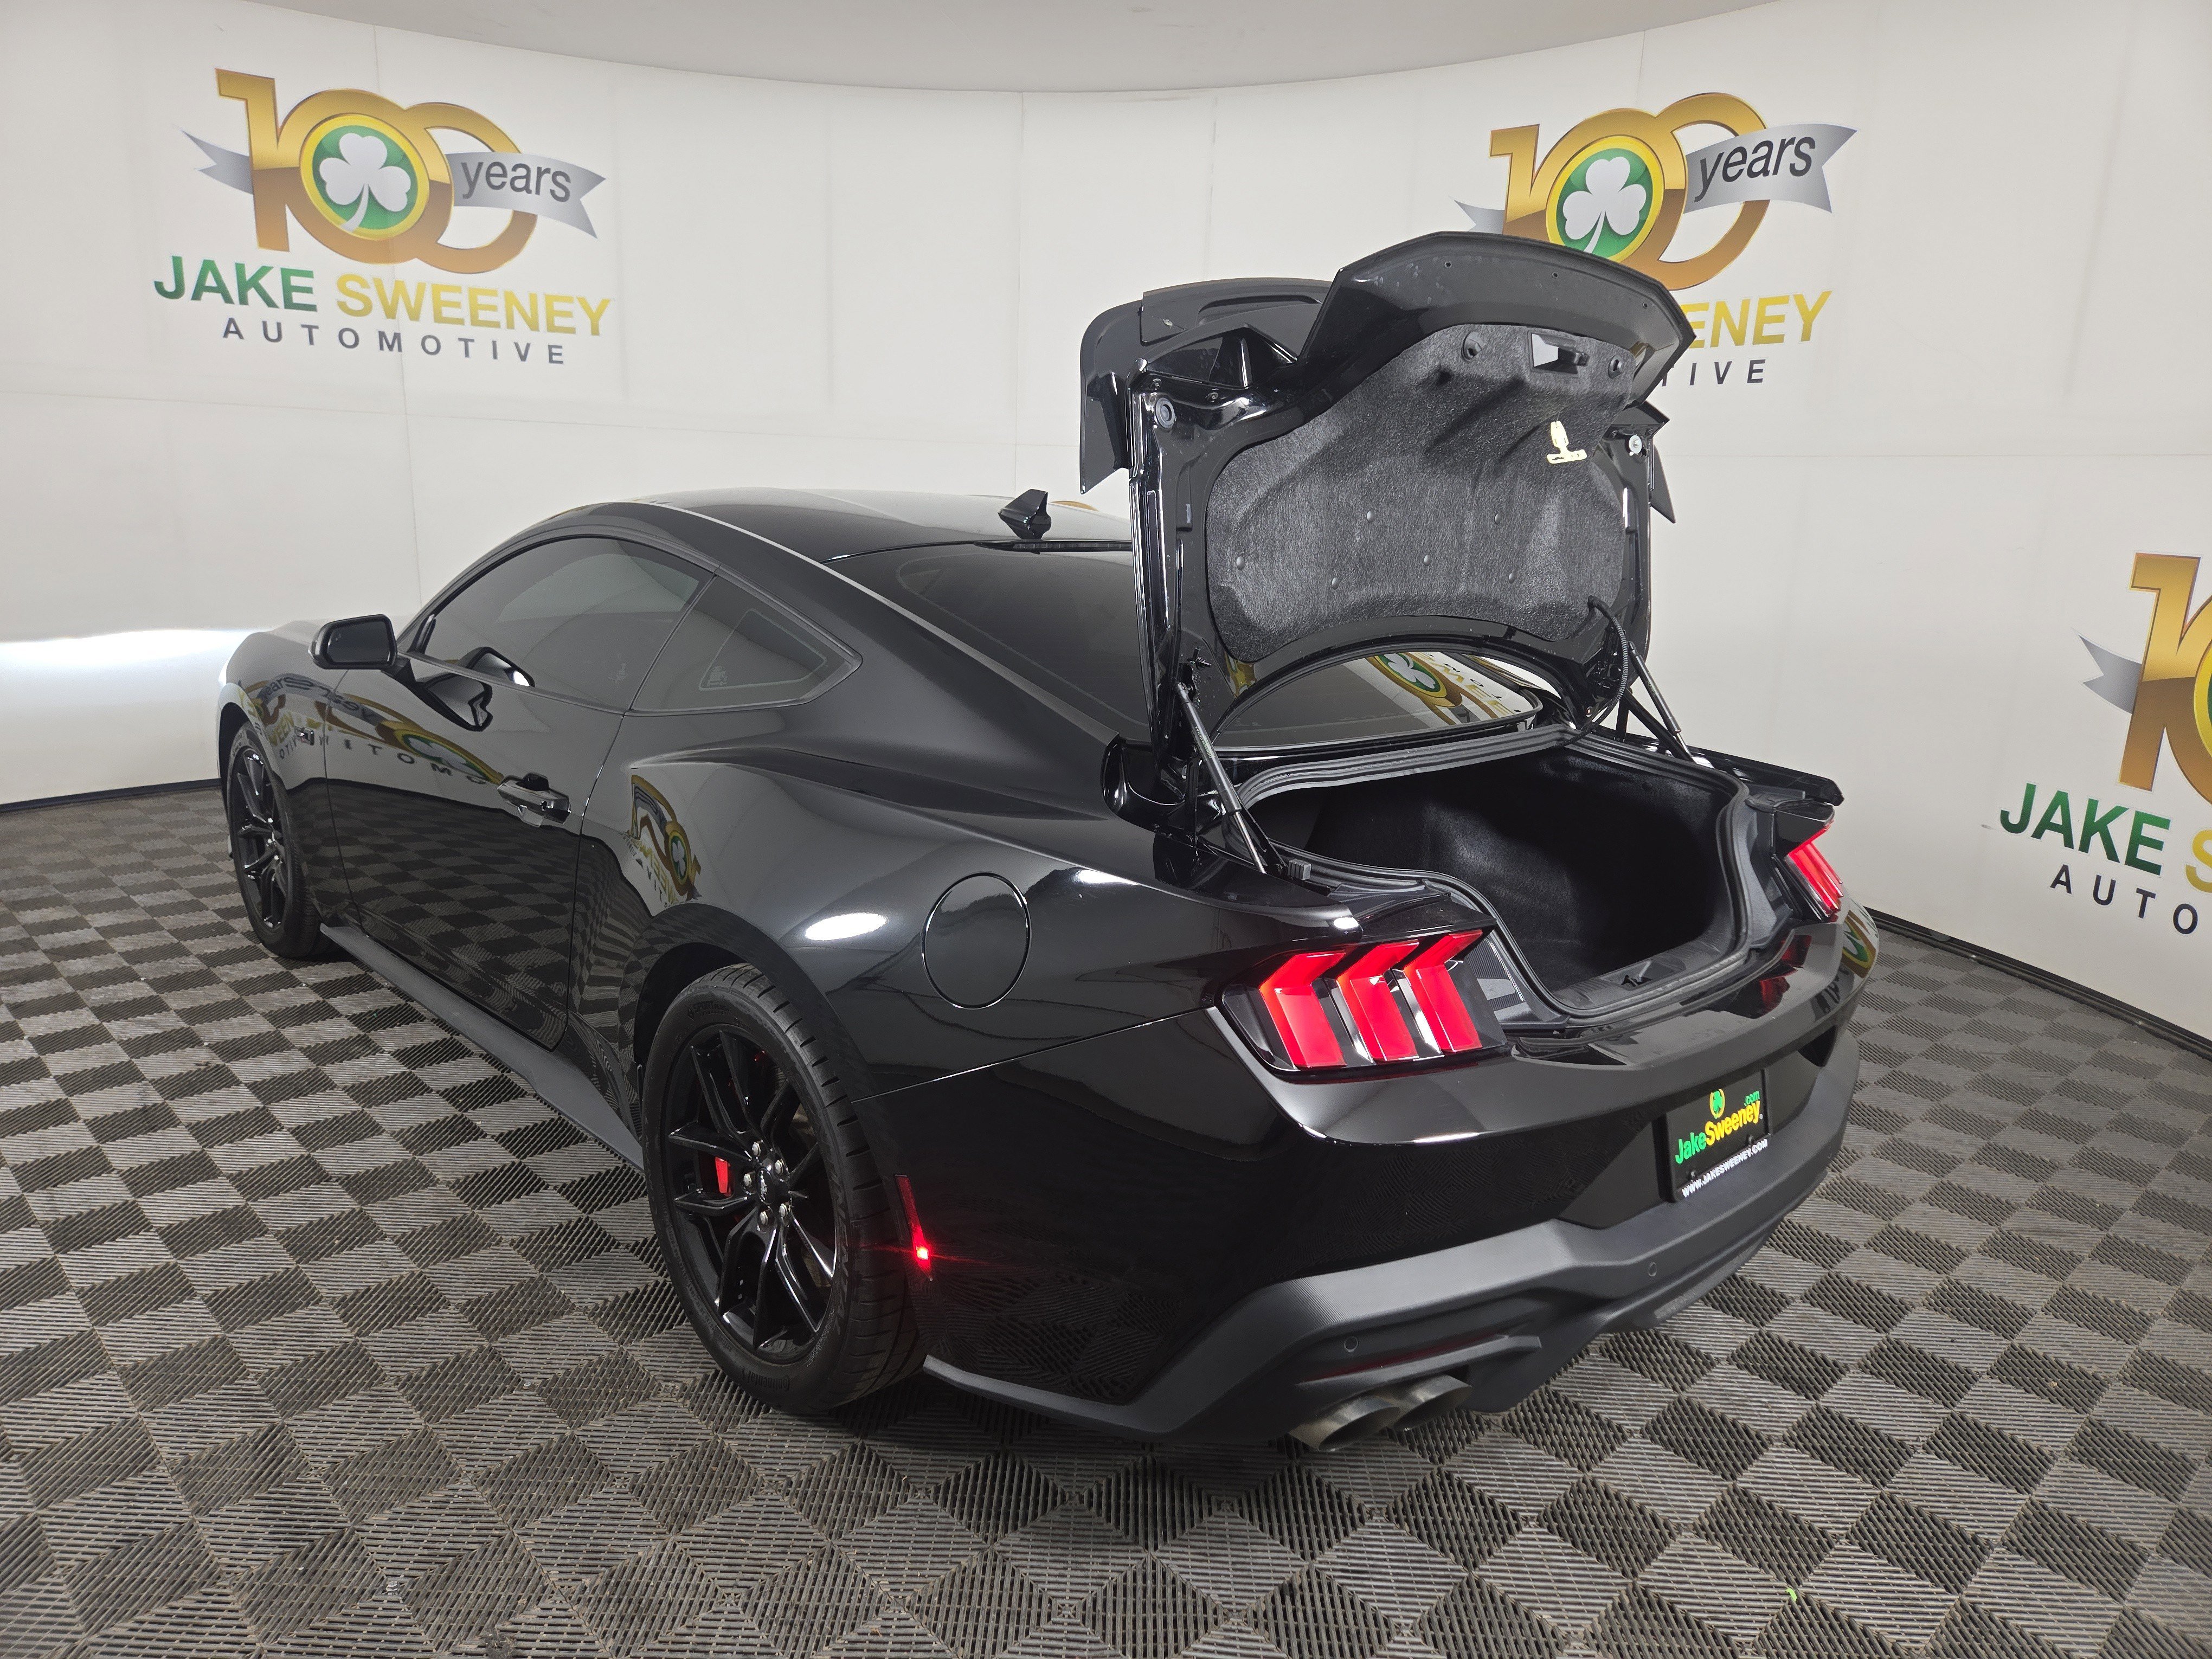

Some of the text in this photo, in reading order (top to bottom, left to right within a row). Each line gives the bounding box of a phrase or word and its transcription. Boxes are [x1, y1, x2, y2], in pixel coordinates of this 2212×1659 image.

[215, 68, 573, 274] 100 years
[1694, 136, 1816, 203] years
[153, 255, 613, 336] JAKE SWEENEY
[1681, 290, 1833, 349] ENEY
[222, 317, 565, 365] AUTOMOTIVE
[1999, 782, 2171, 876] JAKE
[1744, 1091, 1760, 1106] .com
[1681, 1139, 1768, 1198] WWW.JAKESWEENEY.COM
[747, 1371, 790, 1392] Continental
